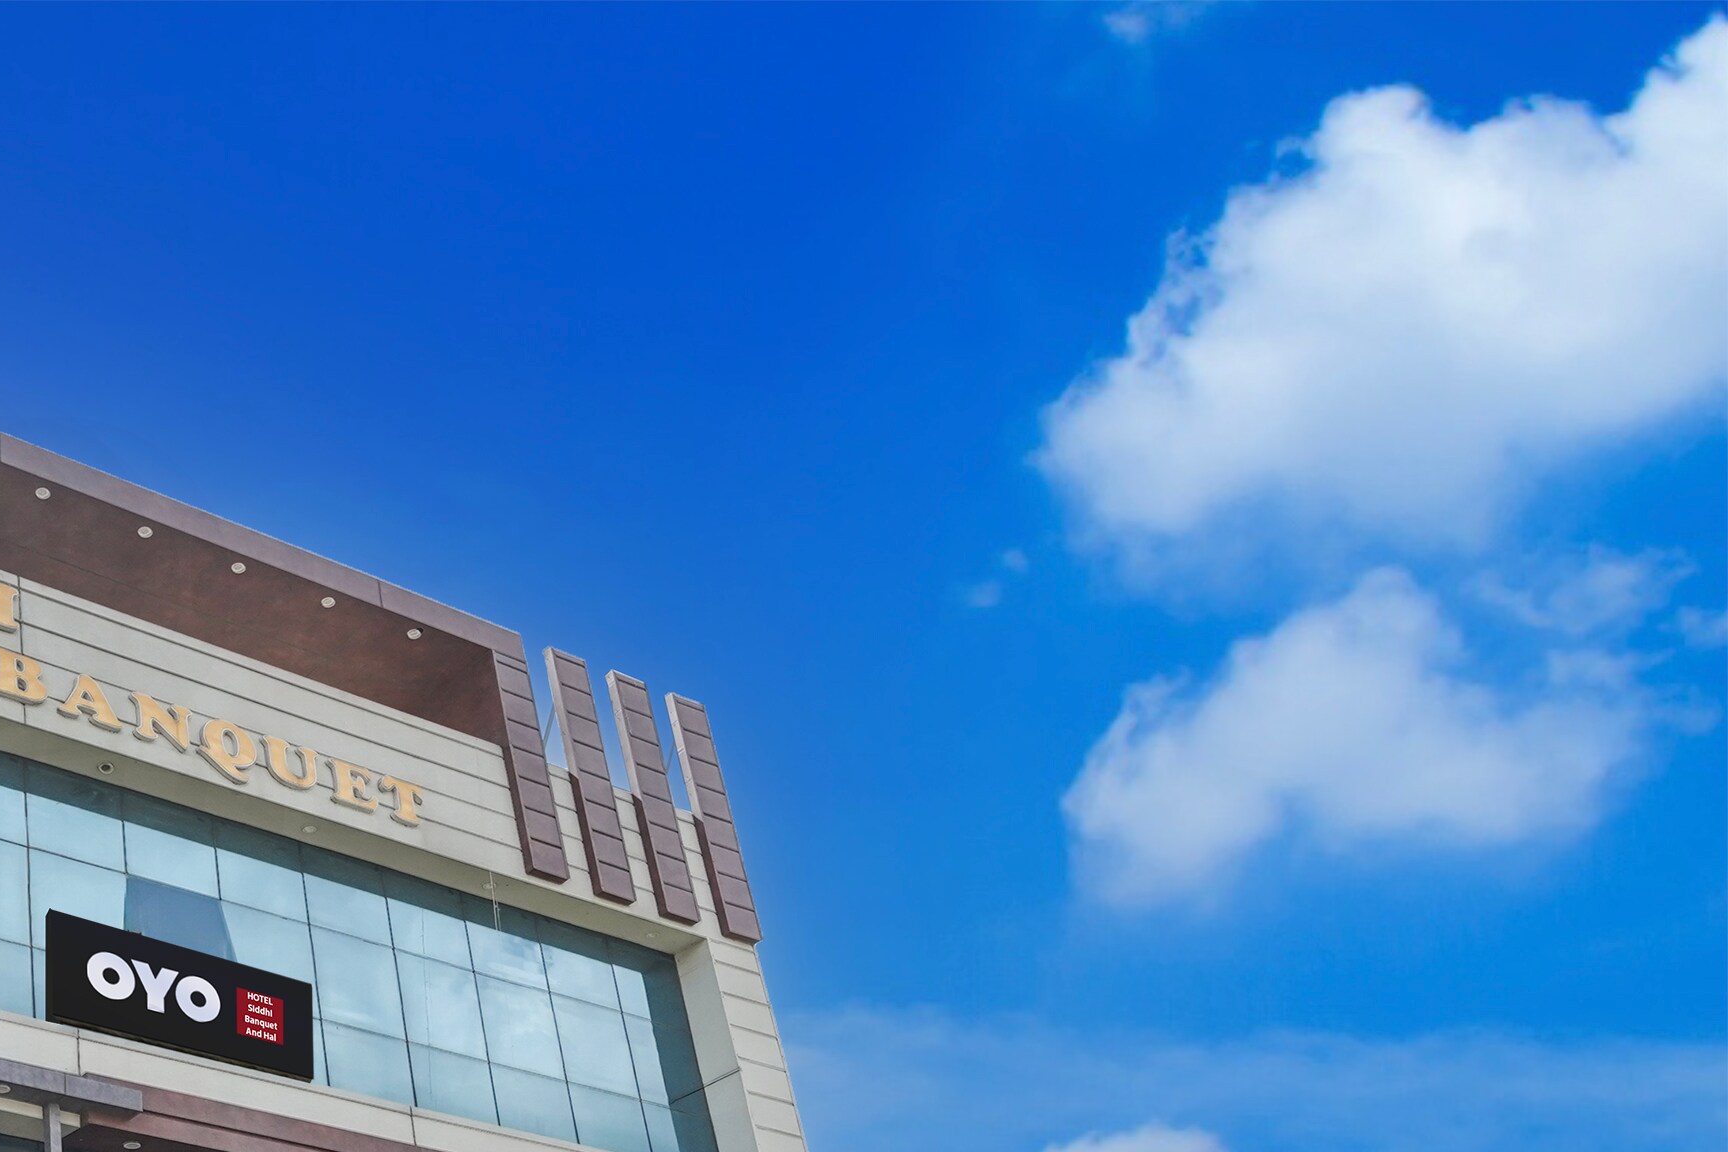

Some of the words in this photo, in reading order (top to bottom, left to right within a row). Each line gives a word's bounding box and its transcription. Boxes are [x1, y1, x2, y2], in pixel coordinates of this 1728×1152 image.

[86, 951, 221, 1023] OYO
[247, 991, 273, 1006] HOTEL
[247, 1004, 273, 1018] Siddhi
[244, 1014, 278, 1031] Banquet
[245, 1027, 262, 1038] And
[263, 1031, 277, 1042] Hal
